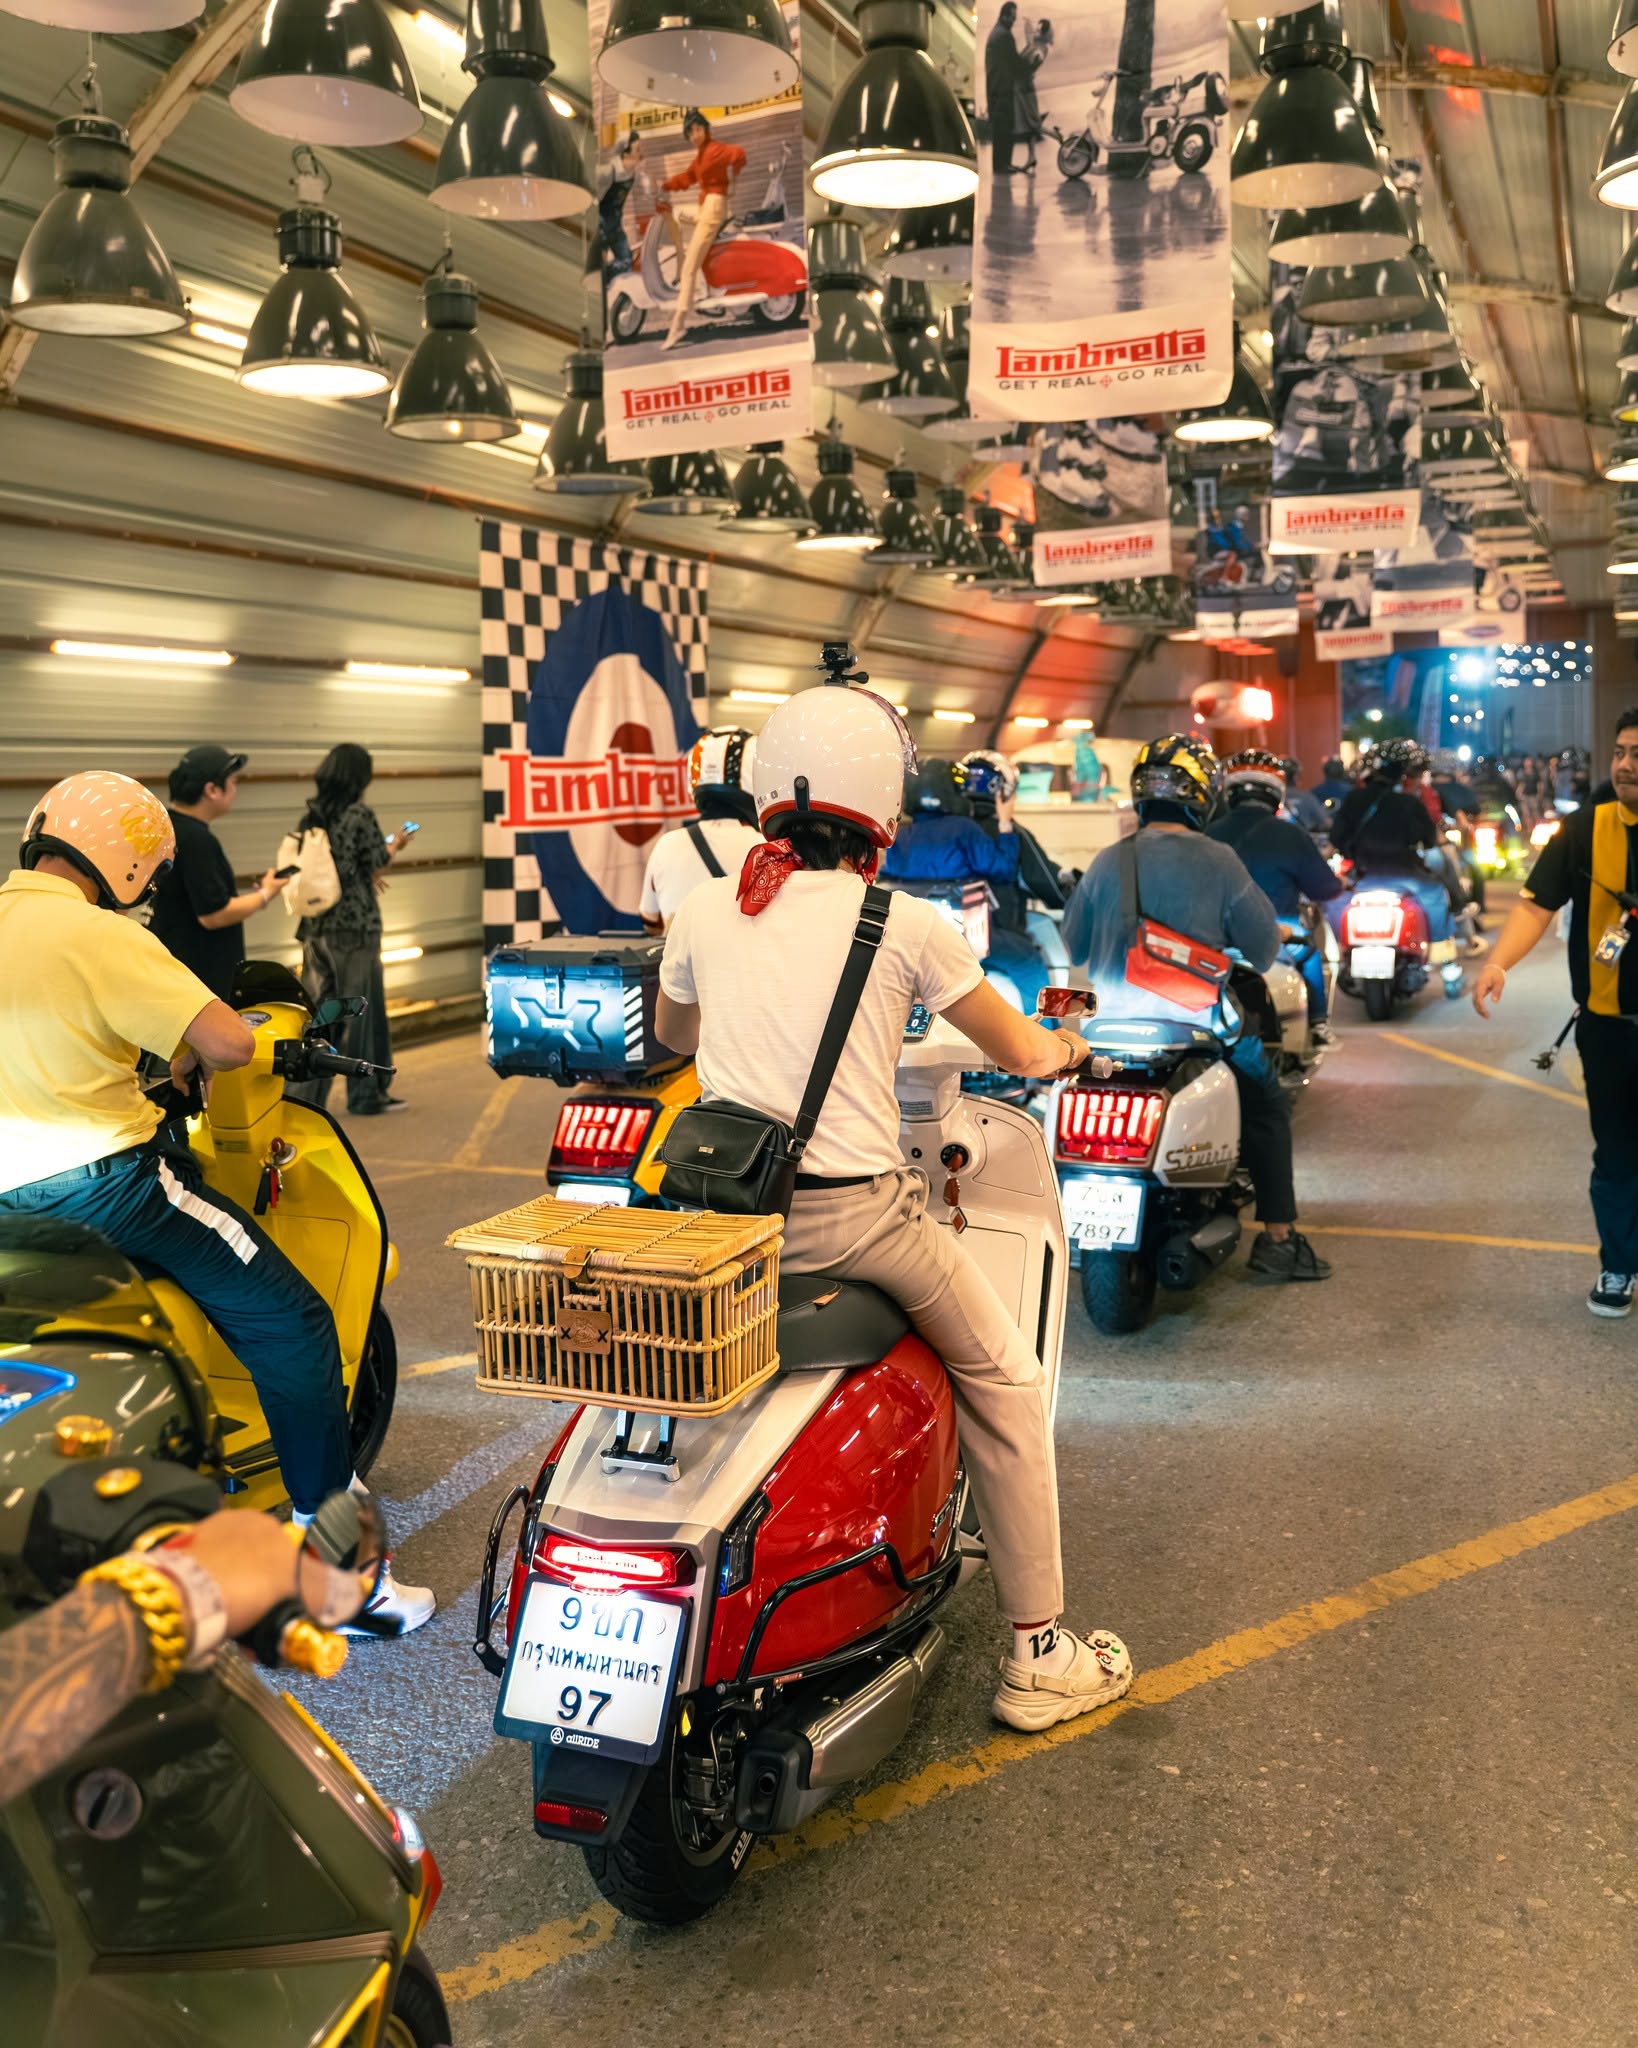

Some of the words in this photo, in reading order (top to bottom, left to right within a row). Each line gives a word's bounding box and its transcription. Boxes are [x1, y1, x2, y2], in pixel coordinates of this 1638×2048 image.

[994, 328, 1206, 378] Lambretta
[998, 379, 1039, 391] GET
[1048, 376, 1097, 390] REAL
[1117, 369, 1145, 382] GO
[1153, 362, 1206, 377] REAL
[621, 369, 791, 420] Lambretta
[626, 417, 656, 431] GET
[662, 411, 701, 425] REAL
[717, 406, 742, 418] GO
[747, 400, 792, 413] REAL
[1286, 504, 1405, 530] Lambretta
[1044, 535, 1153, 562] Lambretta
[1072, 1222, 1127, 1241] 7897
[521, 1639, 664, 1686] กรุงเทพมหานคร
[557, 1685, 614, 1727] 97
